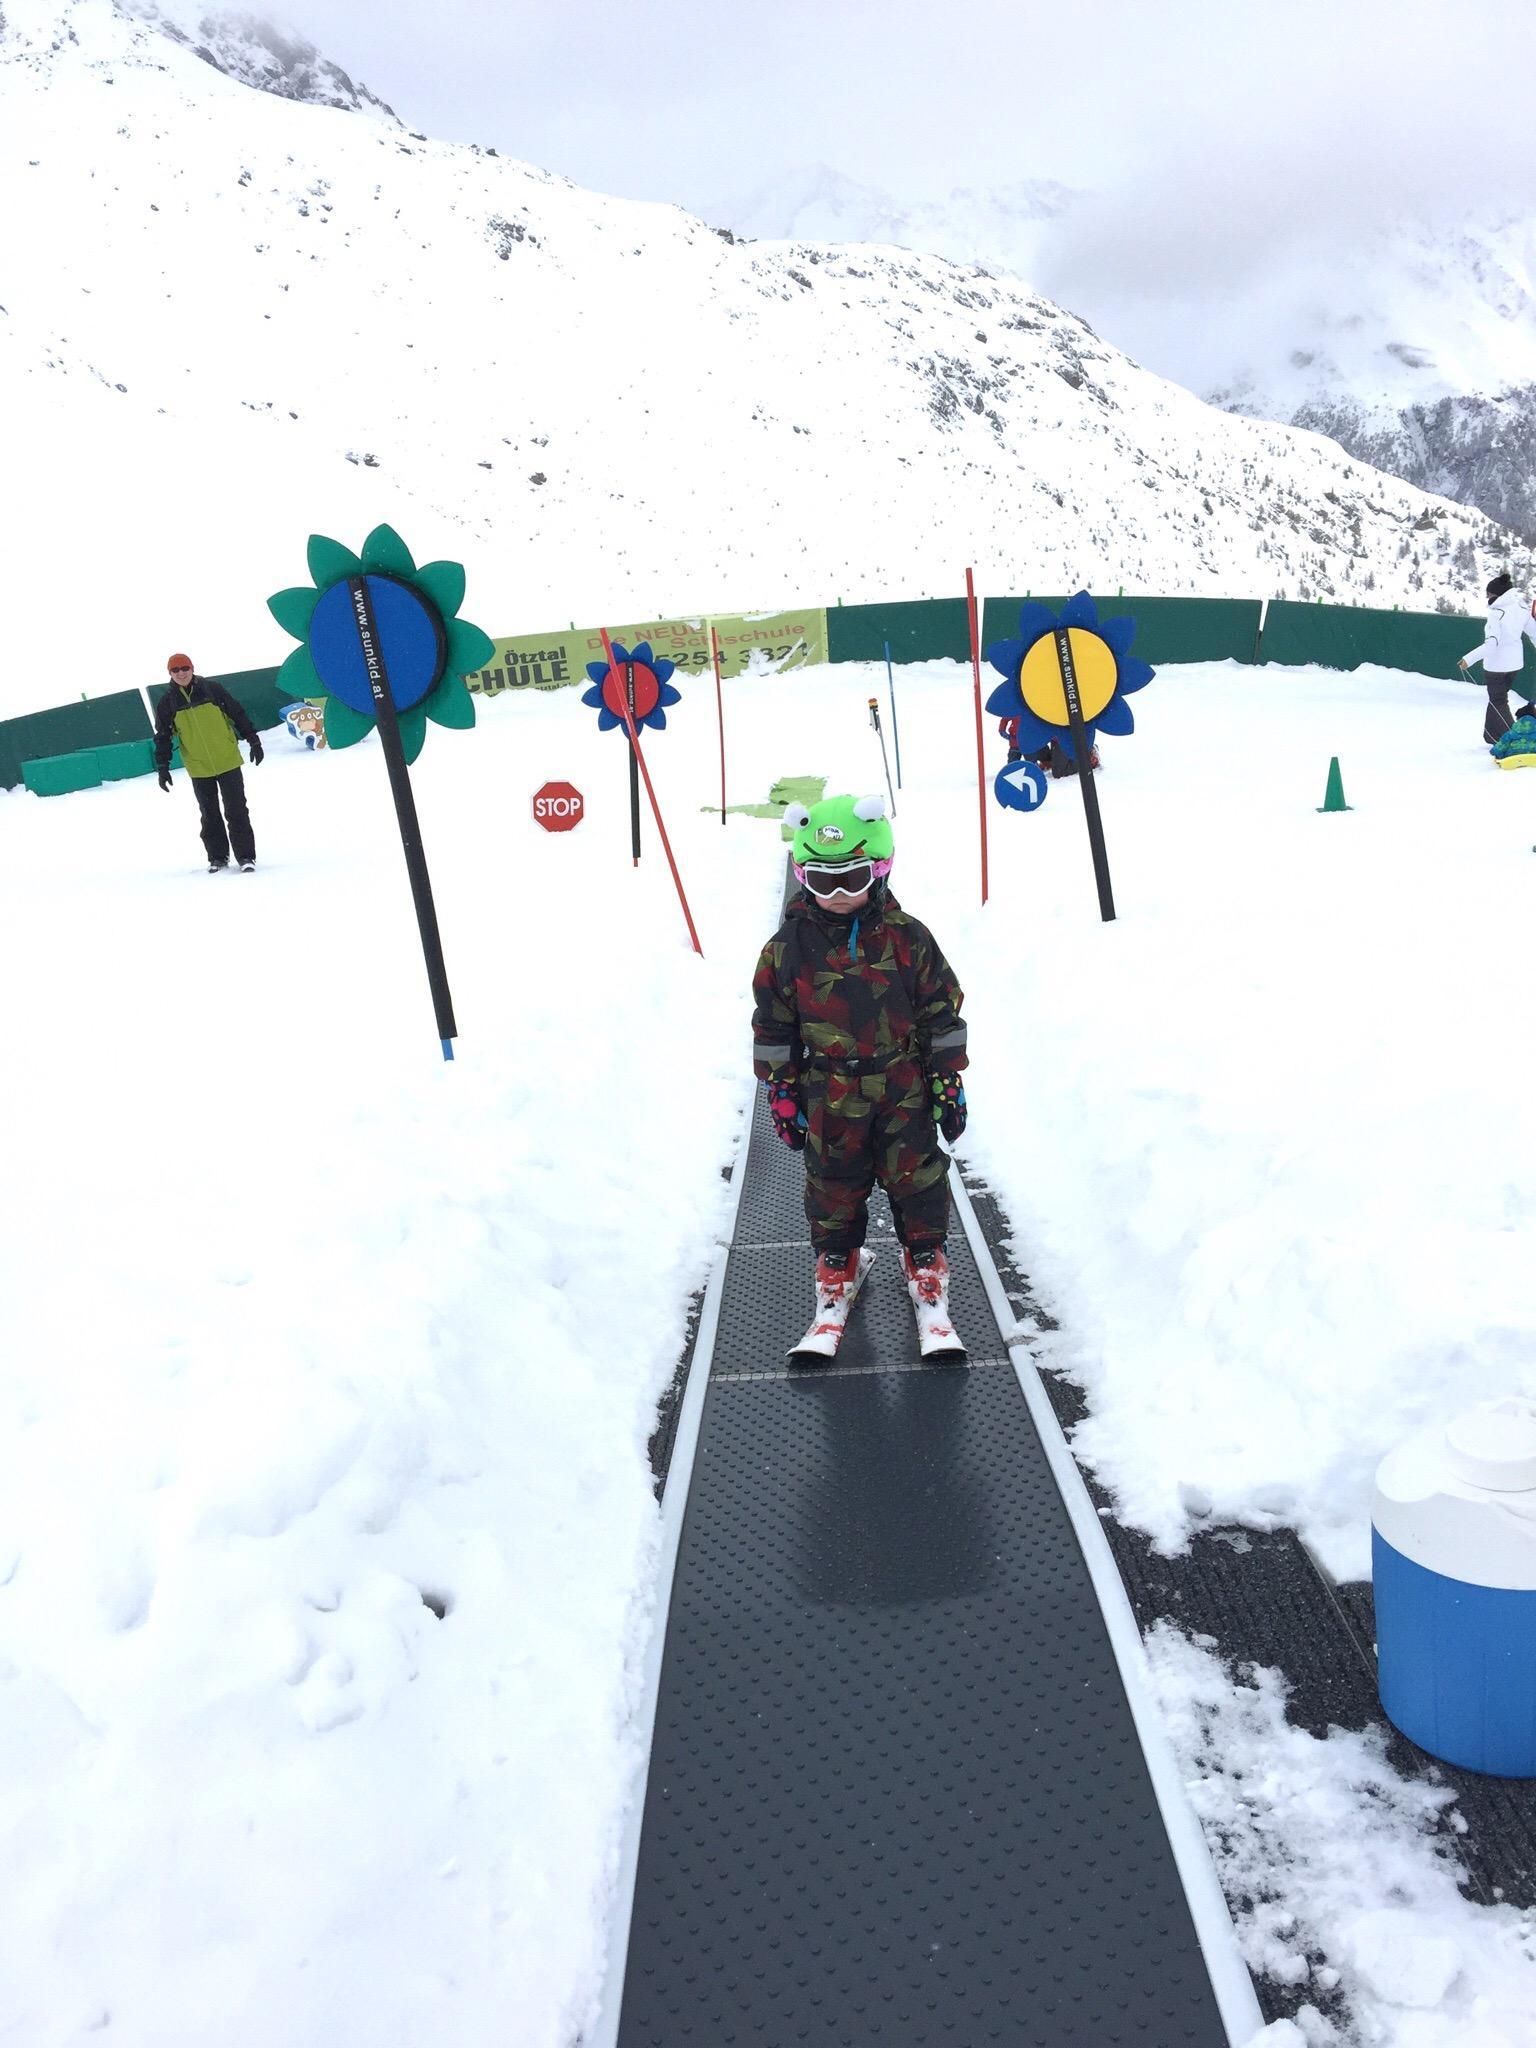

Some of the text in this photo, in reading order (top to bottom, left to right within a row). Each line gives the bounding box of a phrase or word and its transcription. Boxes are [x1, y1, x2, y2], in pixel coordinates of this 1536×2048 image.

[353, 589, 384, 700] www.sunkid.at
[586, 636, 627, 650] De
[504, 646, 567, 666] Ötztal
[1060, 637, 1079, 714] www.sunkid.at
[535, 797, 581, 817] STOP
